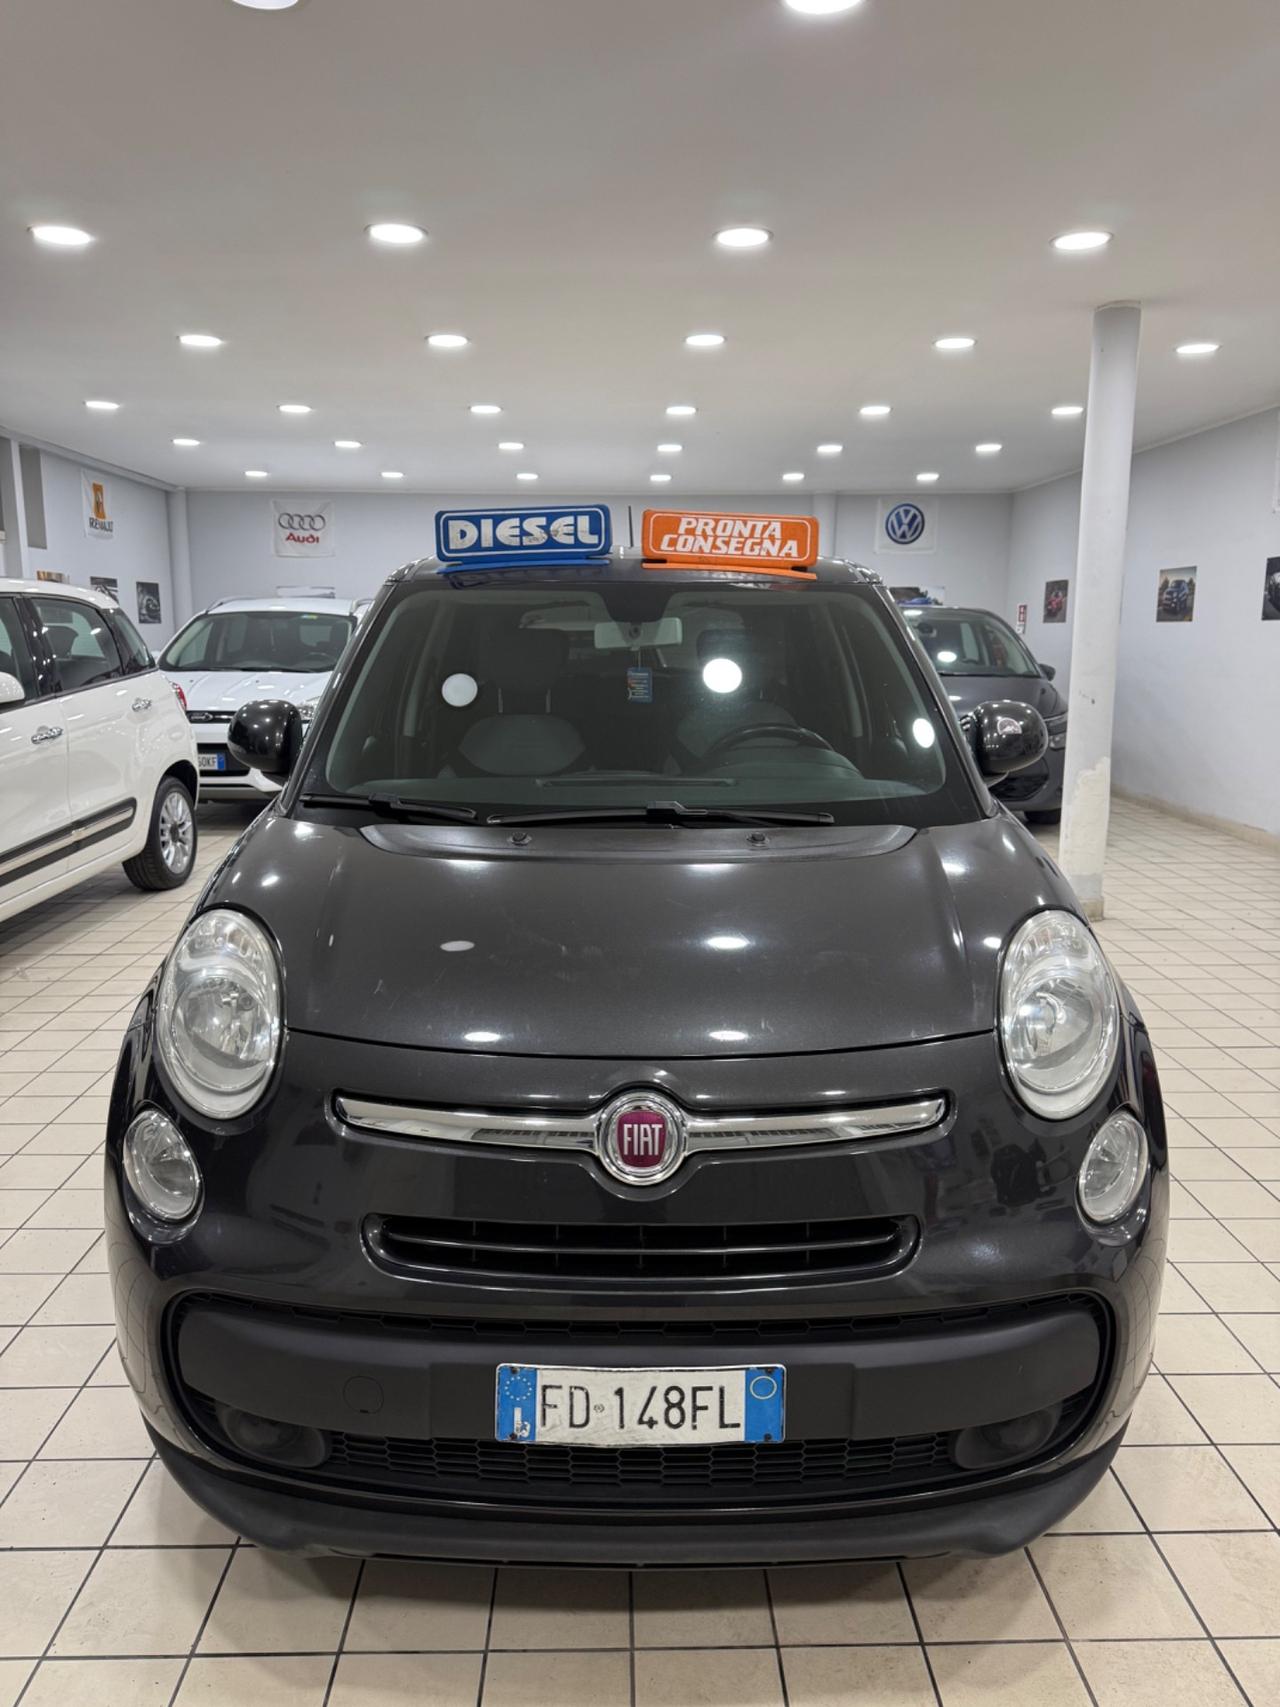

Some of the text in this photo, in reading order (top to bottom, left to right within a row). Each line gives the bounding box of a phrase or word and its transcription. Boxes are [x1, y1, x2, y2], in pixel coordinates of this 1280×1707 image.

[286, 532, 320, 544] Audi
[448, 515, 599, 550] DIESEL
[678, 517, 782, 538] PRONTA
[660, 534, 799, 557] CONSEGNA
[623, 1123, 663, 1156] FIAT
